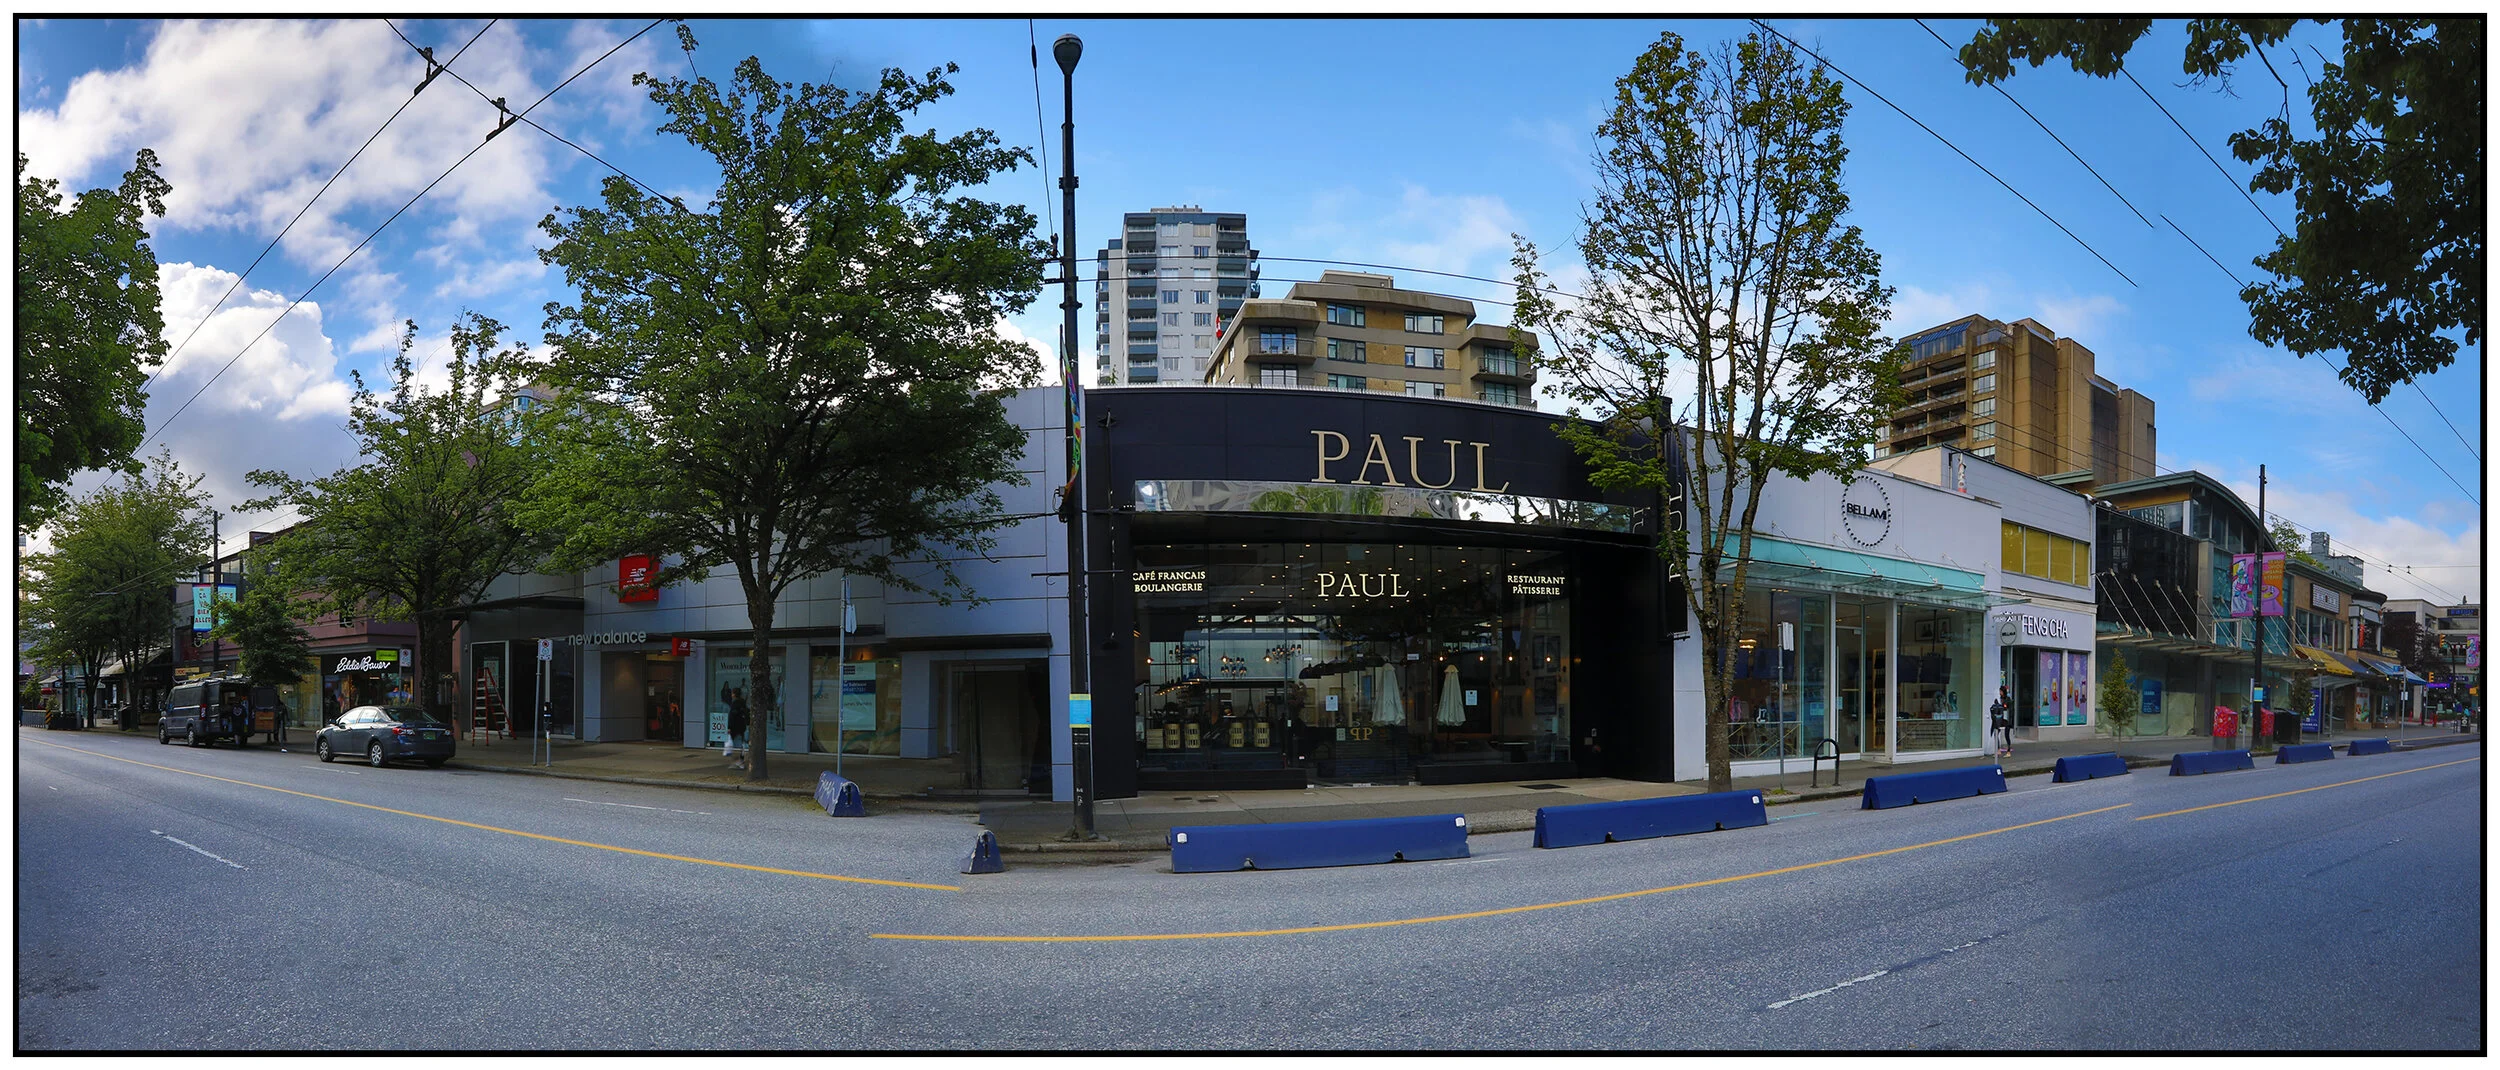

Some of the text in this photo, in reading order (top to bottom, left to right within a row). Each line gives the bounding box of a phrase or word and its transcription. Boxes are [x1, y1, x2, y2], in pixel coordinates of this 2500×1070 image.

[1310, 430, 1510, 494] PAUL
[1846, 502, 1887, 520] BELLAMI
[1668, 482, 1683, 582] PUL
[1132, 571, 1156, 581] CAFÉ
[1317, 573, 1410, 597] PAUL
[1507, 575, 1566, 584] RESTAURANT
[1134, 583, 1203, 592] BOULANGERIE
[1512, 584, 1561, 595] PÂTISSERIE
[2022, 614, 2048, 637] FENG
[2049, 618, 2069, 639] CHA
[568, 628, 647, 646] new balance
[334, 657, 361, 674] Eddie
[360, 656, 391, 672] Bauer
